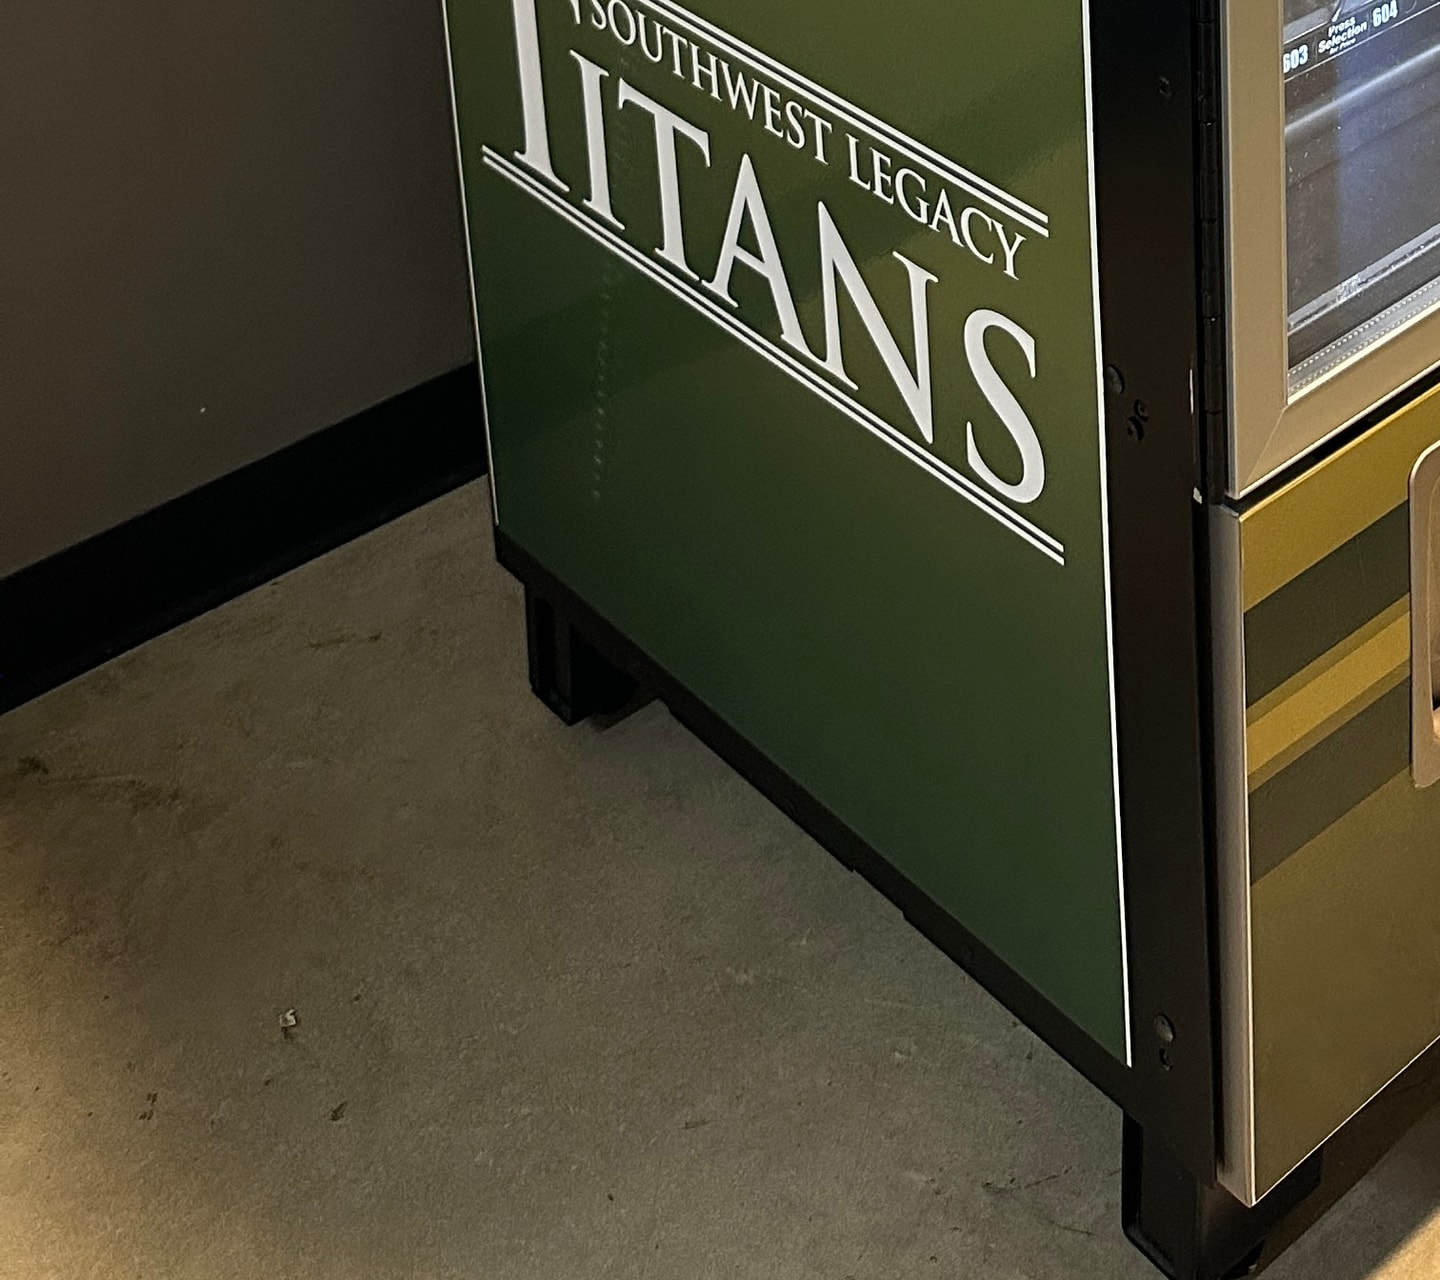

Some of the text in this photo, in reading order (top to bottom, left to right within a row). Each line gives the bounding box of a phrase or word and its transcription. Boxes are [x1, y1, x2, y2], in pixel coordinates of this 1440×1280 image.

[1328, 16, 1356, 38] Press
[1372, 0, 1398, 27] 604
[1317, 21, 1368, 54] Selection
[1282, 44, 1309, 74] 603
[847, 132, 1028, 282] LEGACY
